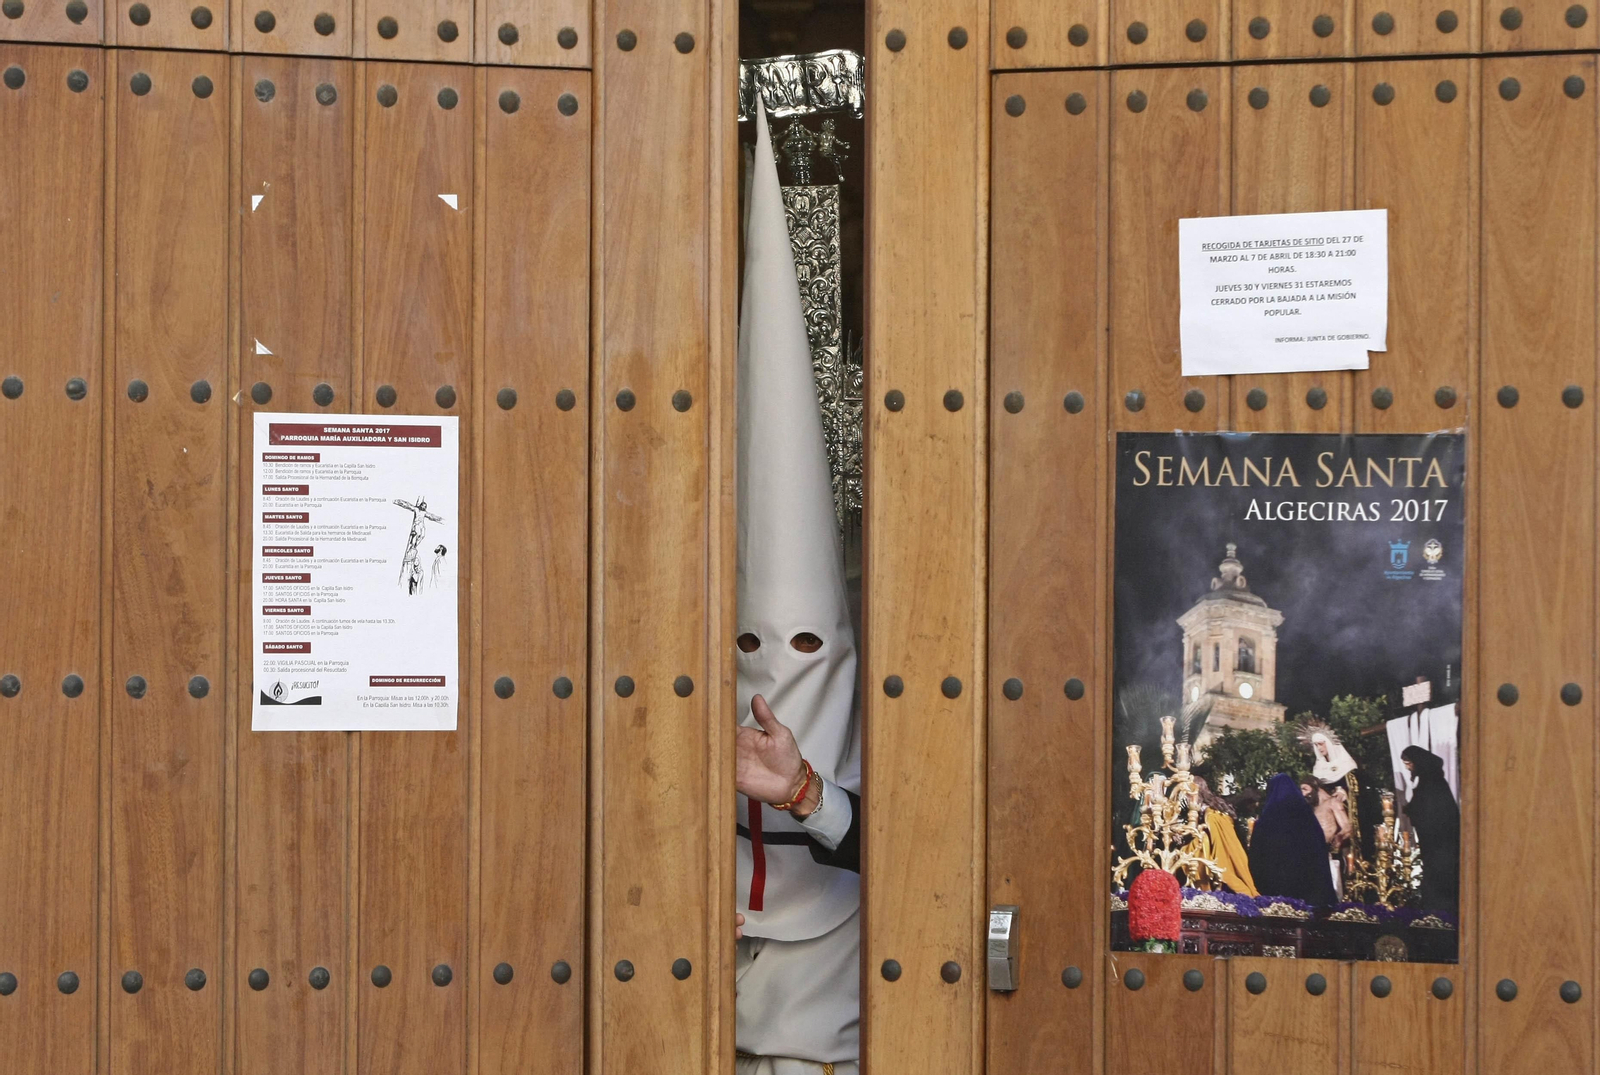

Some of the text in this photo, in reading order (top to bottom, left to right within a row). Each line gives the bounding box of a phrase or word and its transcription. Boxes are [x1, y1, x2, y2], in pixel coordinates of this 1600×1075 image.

[1202, 242, 1241, 250] RECOGIDA
[1254, 239, 1291, 248] TARJETAS
[1210, 255, 1238, 263] MARZO
[1239, 254, 1250, 262] AL
[1304, 251, 1326, 259] 18:30
[1215, 284, 1242, 292] JUEVES
[1243, 283, 1253, 291] 30
[1261, 282, 1293, 290] VIERNES
[1305, 279, 1352, 288] ESTAREMOS
[1211, 297, 1247, 306] CERRADO
[1277, 295, 1307, 303] BAJADA
[1327, 291, 1356, 301] MISIÓN
[1132, 450, 1449, 488] SEMANA SANTA
[1244, 498, 1449, 522] ALGECIRAS 2017
